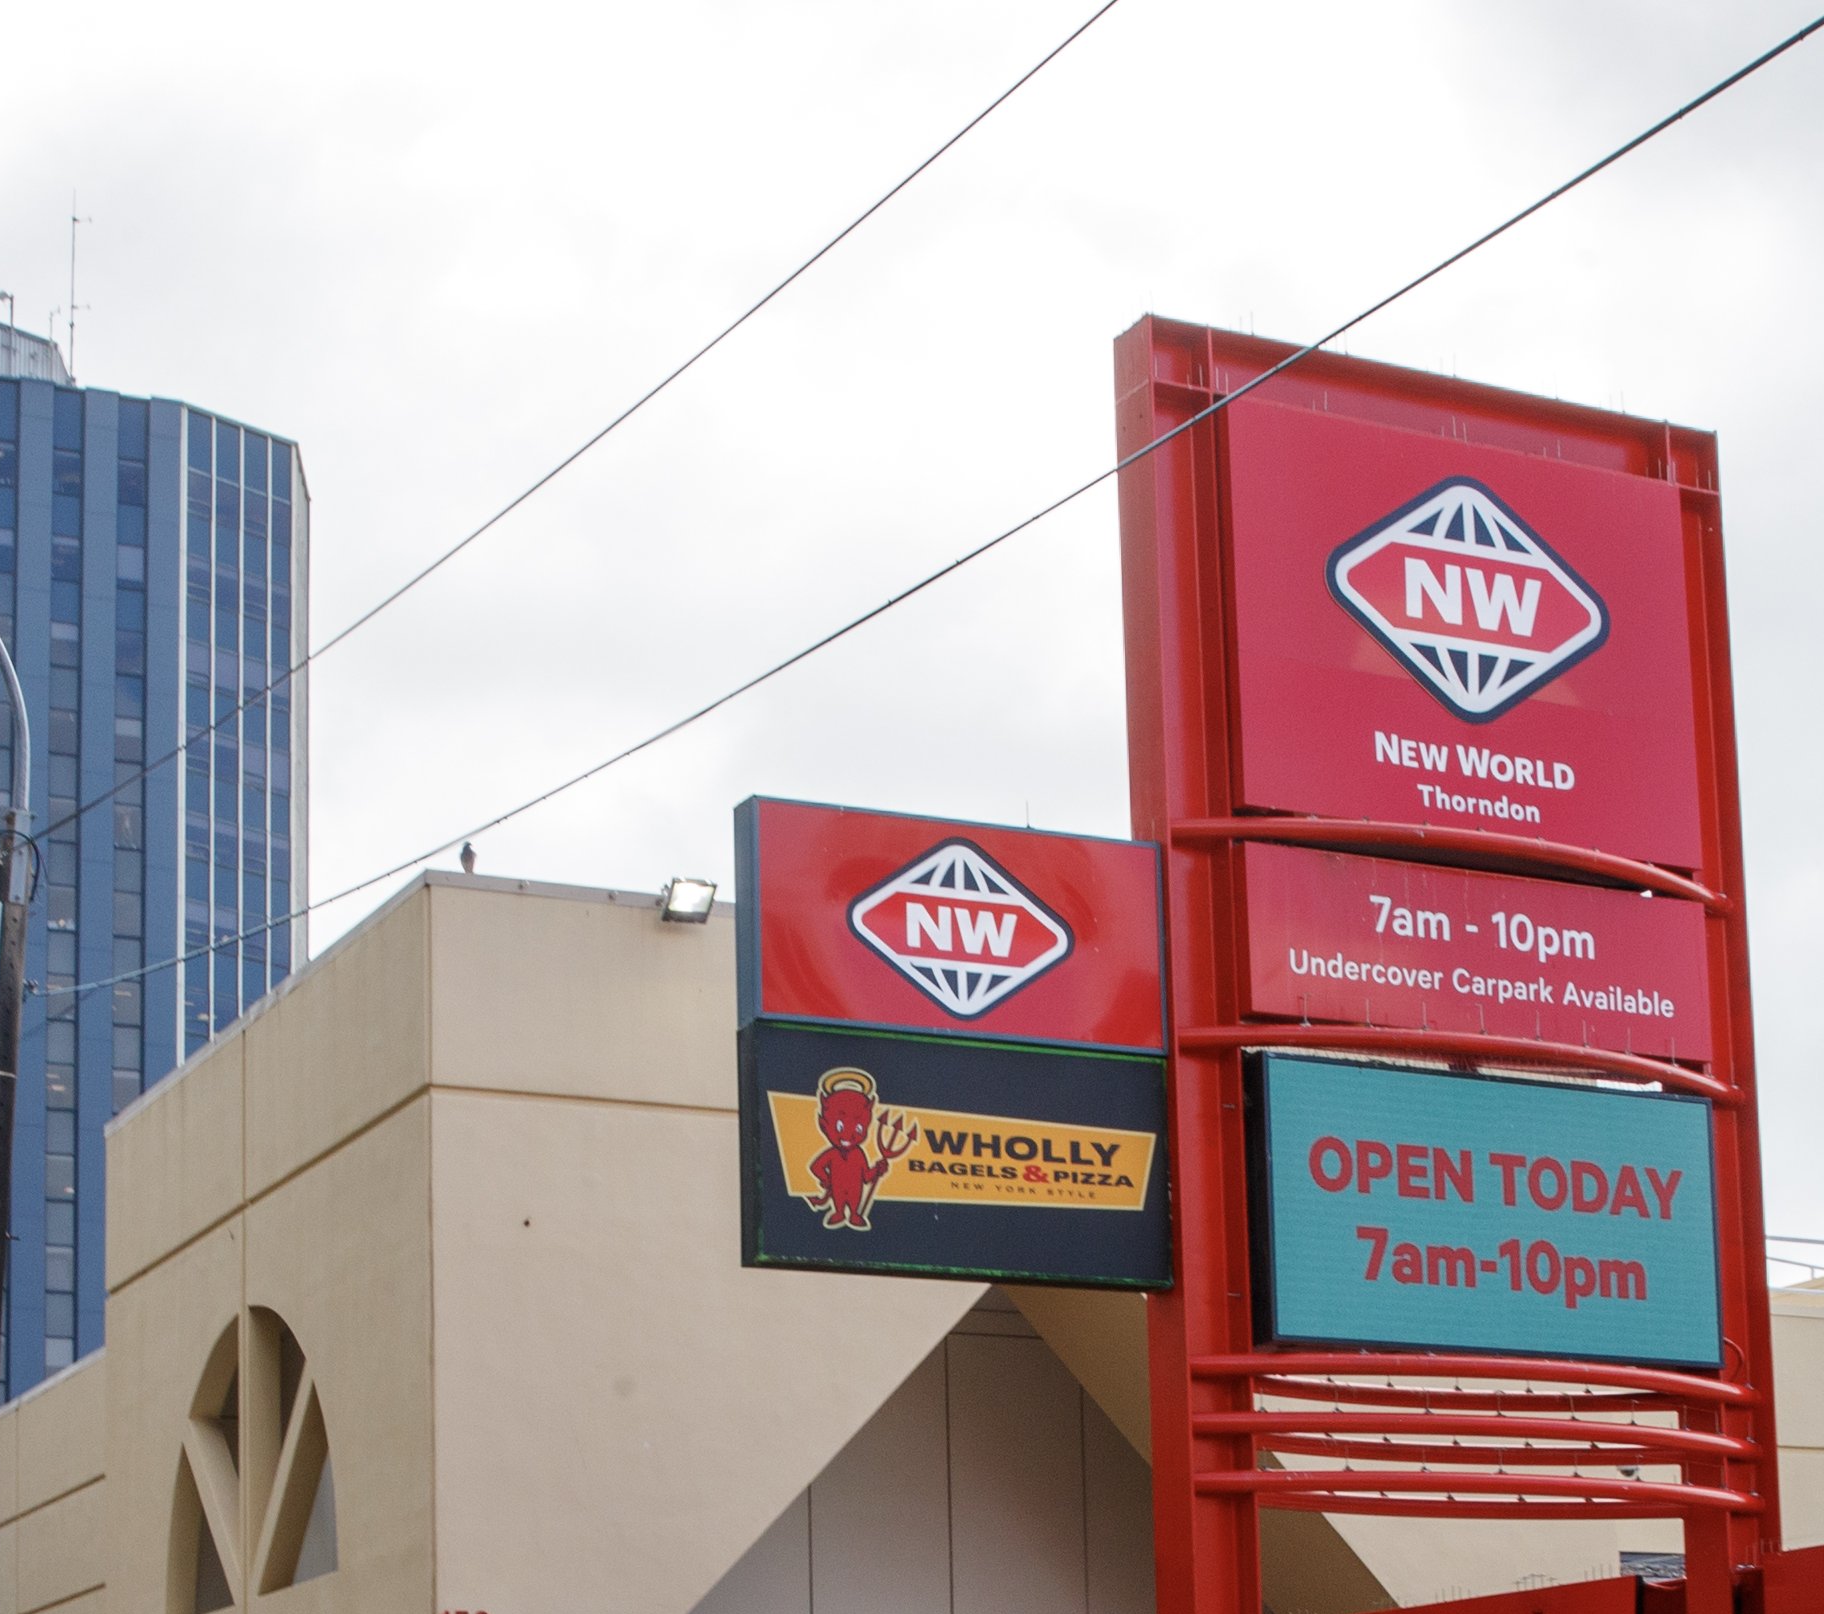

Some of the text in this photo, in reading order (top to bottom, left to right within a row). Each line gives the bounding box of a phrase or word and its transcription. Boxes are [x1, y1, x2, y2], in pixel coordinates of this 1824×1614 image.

[1404, 558, 1542, 637] NW
[1374, 730, 1576, 791] NEW WORLD
[1417, 784, 1541, 825] Thorndon
[905, 901, 1018, 958] NW
[1369, 894, 1452, 943] 7am
[1490, 911, 1596, 964] 10pm
[1289, 946, 1676, 1019] Undercover Carpark Available
[908, 1159, 1135, 1189] BAGELS & PIZZA
[923, 1128, 1121, 1168] WHOLLY
[1308, 1135, 1683, 1221] OPEN TODAY
[950, 1180, 1097, 1199] NEW YORK STYLE
[1356, 1225, 1647, 1309] 7am-10pm
